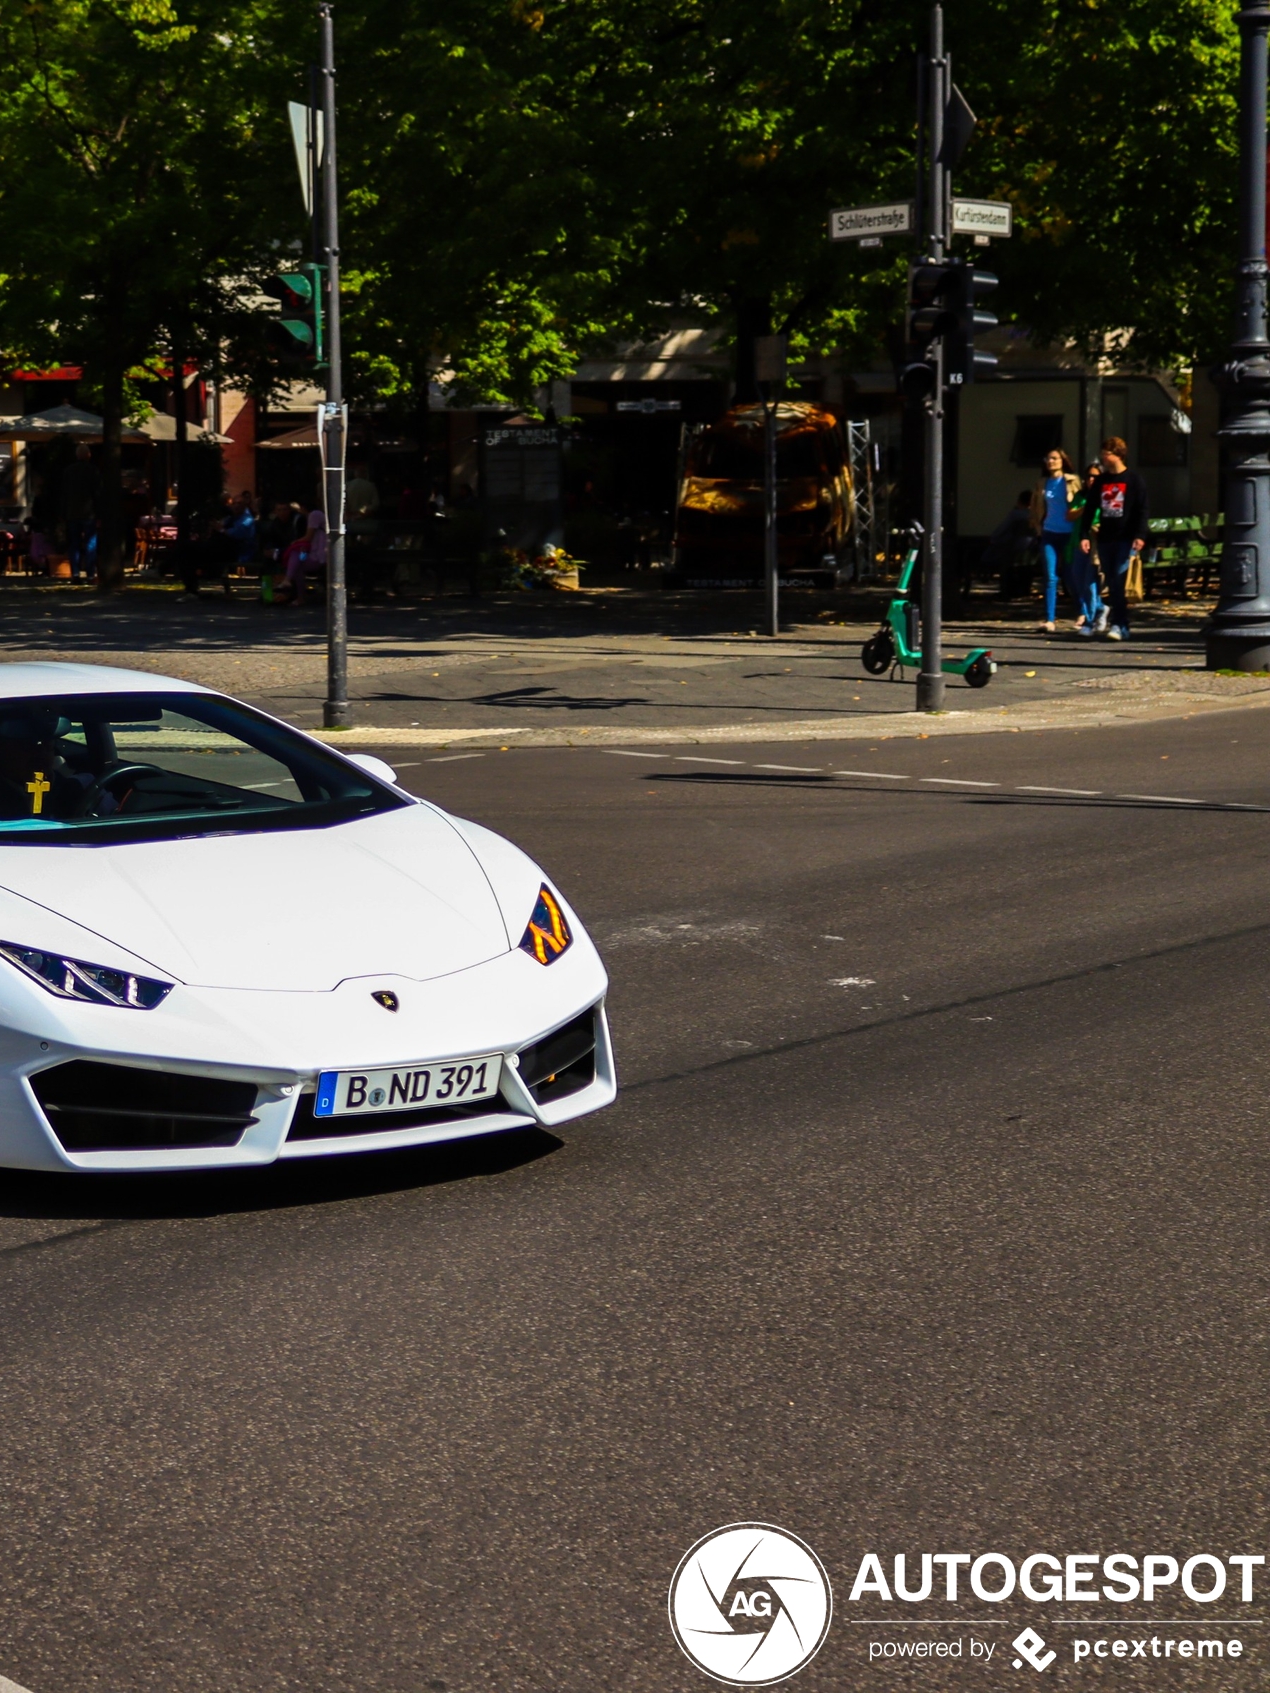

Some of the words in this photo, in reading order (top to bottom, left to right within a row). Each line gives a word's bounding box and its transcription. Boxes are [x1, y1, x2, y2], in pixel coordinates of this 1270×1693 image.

[837, 210, 905, 231] Schlüterstraße
[955, 207, 1007, 226] Kurfürstendamm
[949, 372, 964, 385] K6
[485, 428, 559, 439] TESTAMENT
[485, 437, 502, 447] OF
[518, 436, 559, 446] BUCHA
[686, 578, 754, 588] TESTAMENT
[777, 578, 816, 588] BUCHA
[321, 1098, 329, 1108] D
[346, 1075, 369, 1109] B
[388, 1070, 431, 1106] ND
[436, 1062, 488, 1099] 391
